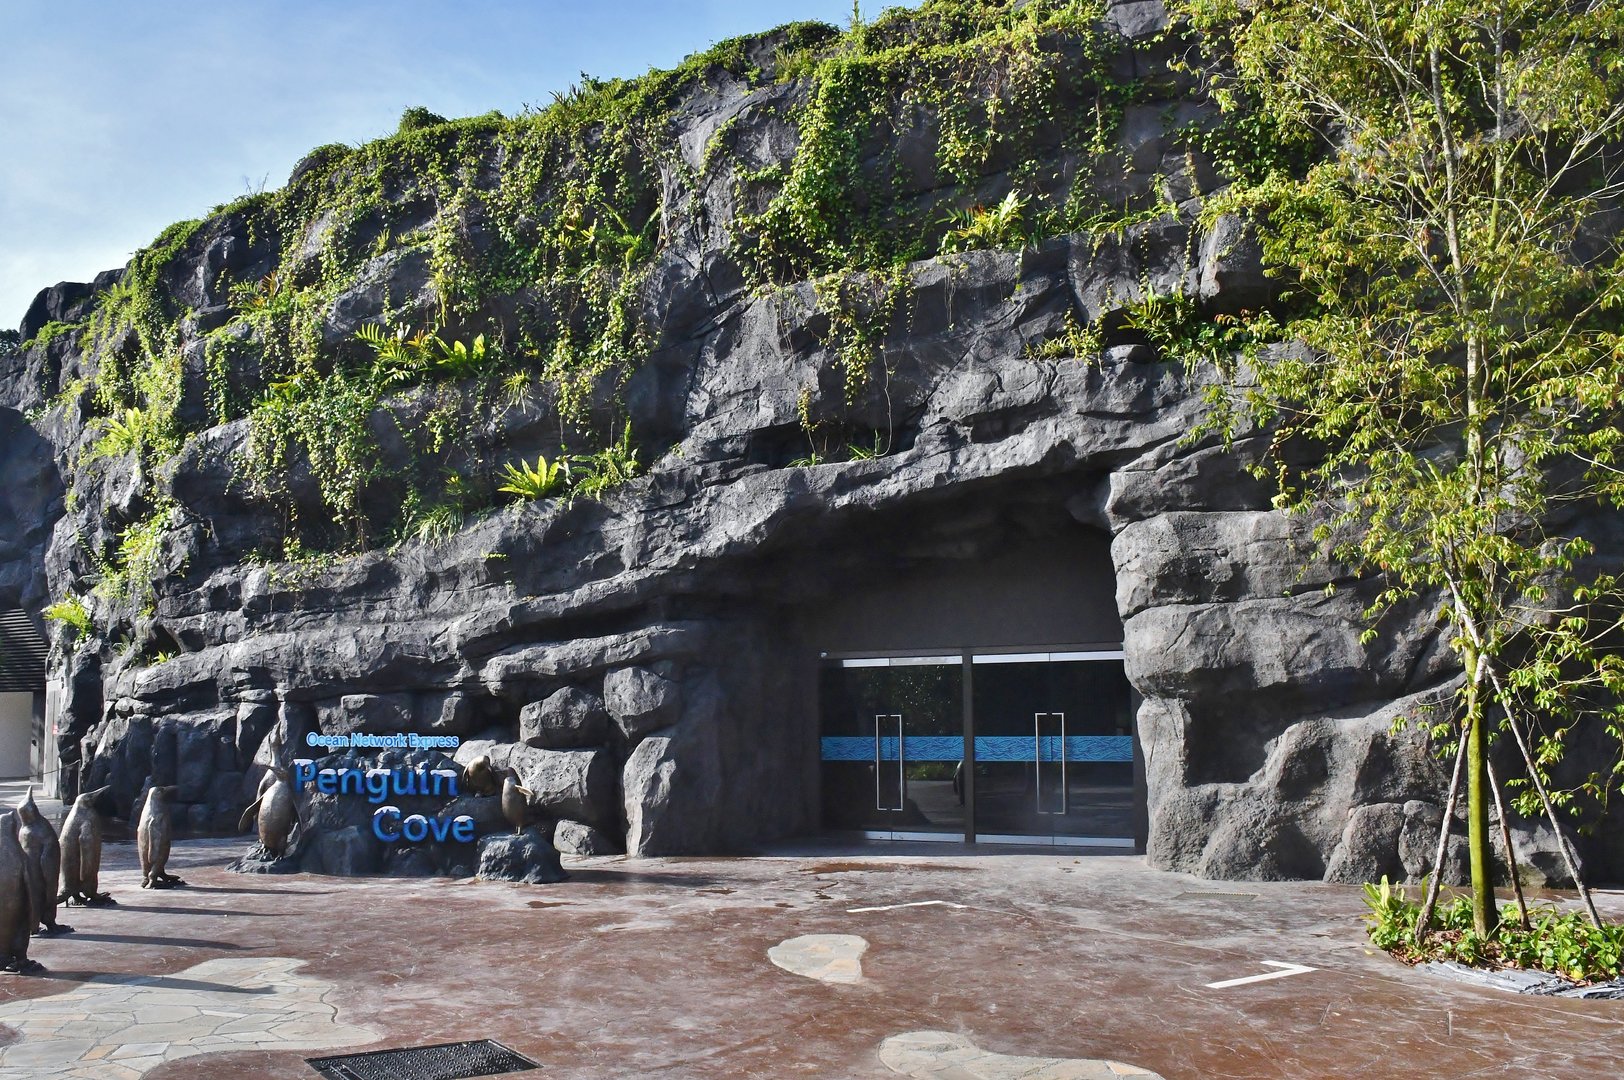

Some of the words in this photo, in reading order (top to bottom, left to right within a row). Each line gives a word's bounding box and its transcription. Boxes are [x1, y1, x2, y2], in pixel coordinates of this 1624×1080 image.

[306, 732, 349, 748] Ocean
[350, 733, 407, 748] Network
[408, 733, 459, 750] Express
[293, 758, 458, 804] Penguin
[372, 805, 475, 843] Cove
